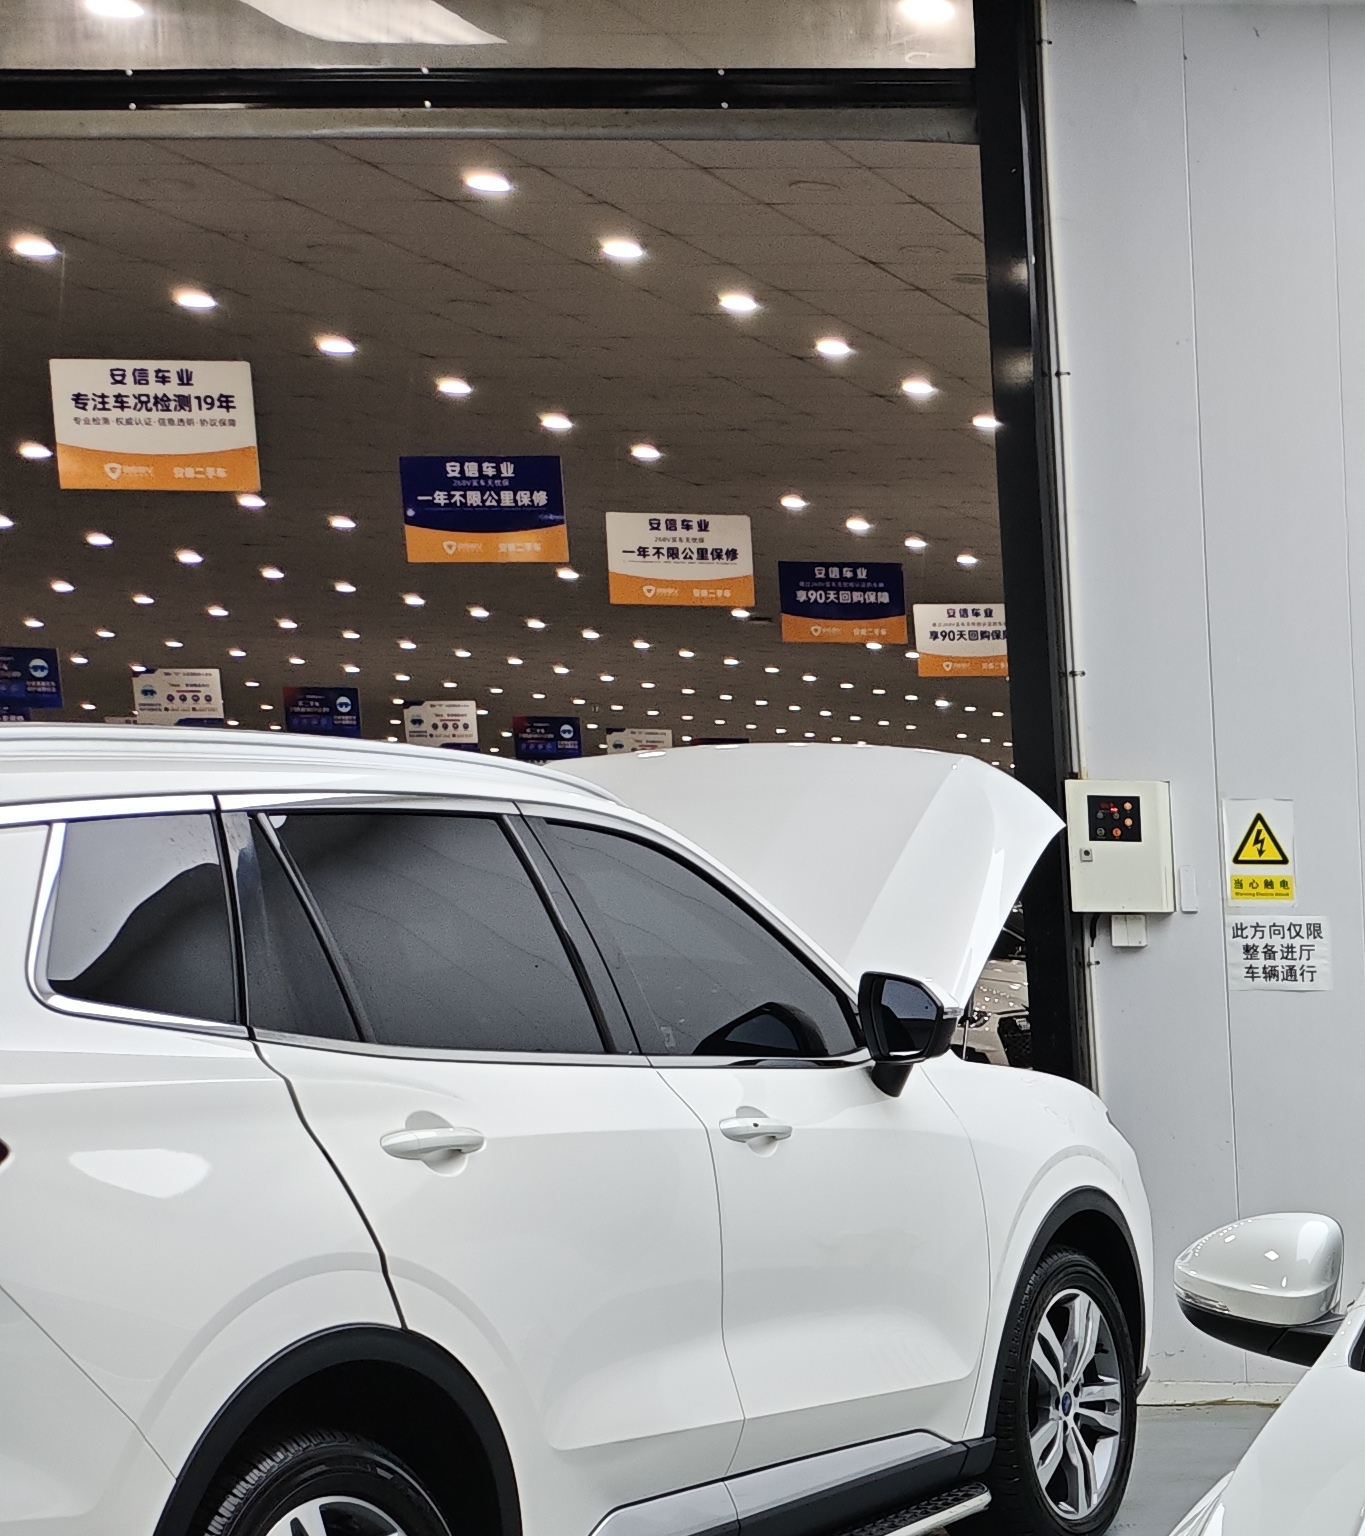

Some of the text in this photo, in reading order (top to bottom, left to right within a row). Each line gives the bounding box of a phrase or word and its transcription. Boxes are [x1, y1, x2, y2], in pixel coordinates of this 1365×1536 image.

[109, 368, 195, 386] 安信车业
[70, 393, 237, 413] 专注车况检测19年
[445, 461, 516, 477] 安信车业
[416, 490, 549, 507] 一年不限公里保修
[648, 518, 711, 532] 安信车业
[621, 546, 739, 561] 一年不限公里保修
[814, 566, 868, 579] 安信车业
[795, 590, 890, 604] 享90天回购保障
[1233, 878, 1291, 890] 当心触电
[1231, 921, 1324, 940] 此方向仅限
[1242, 942, 1316, 961] 整备进厅
[1243, 963, 1318, 982] 车辆通行
